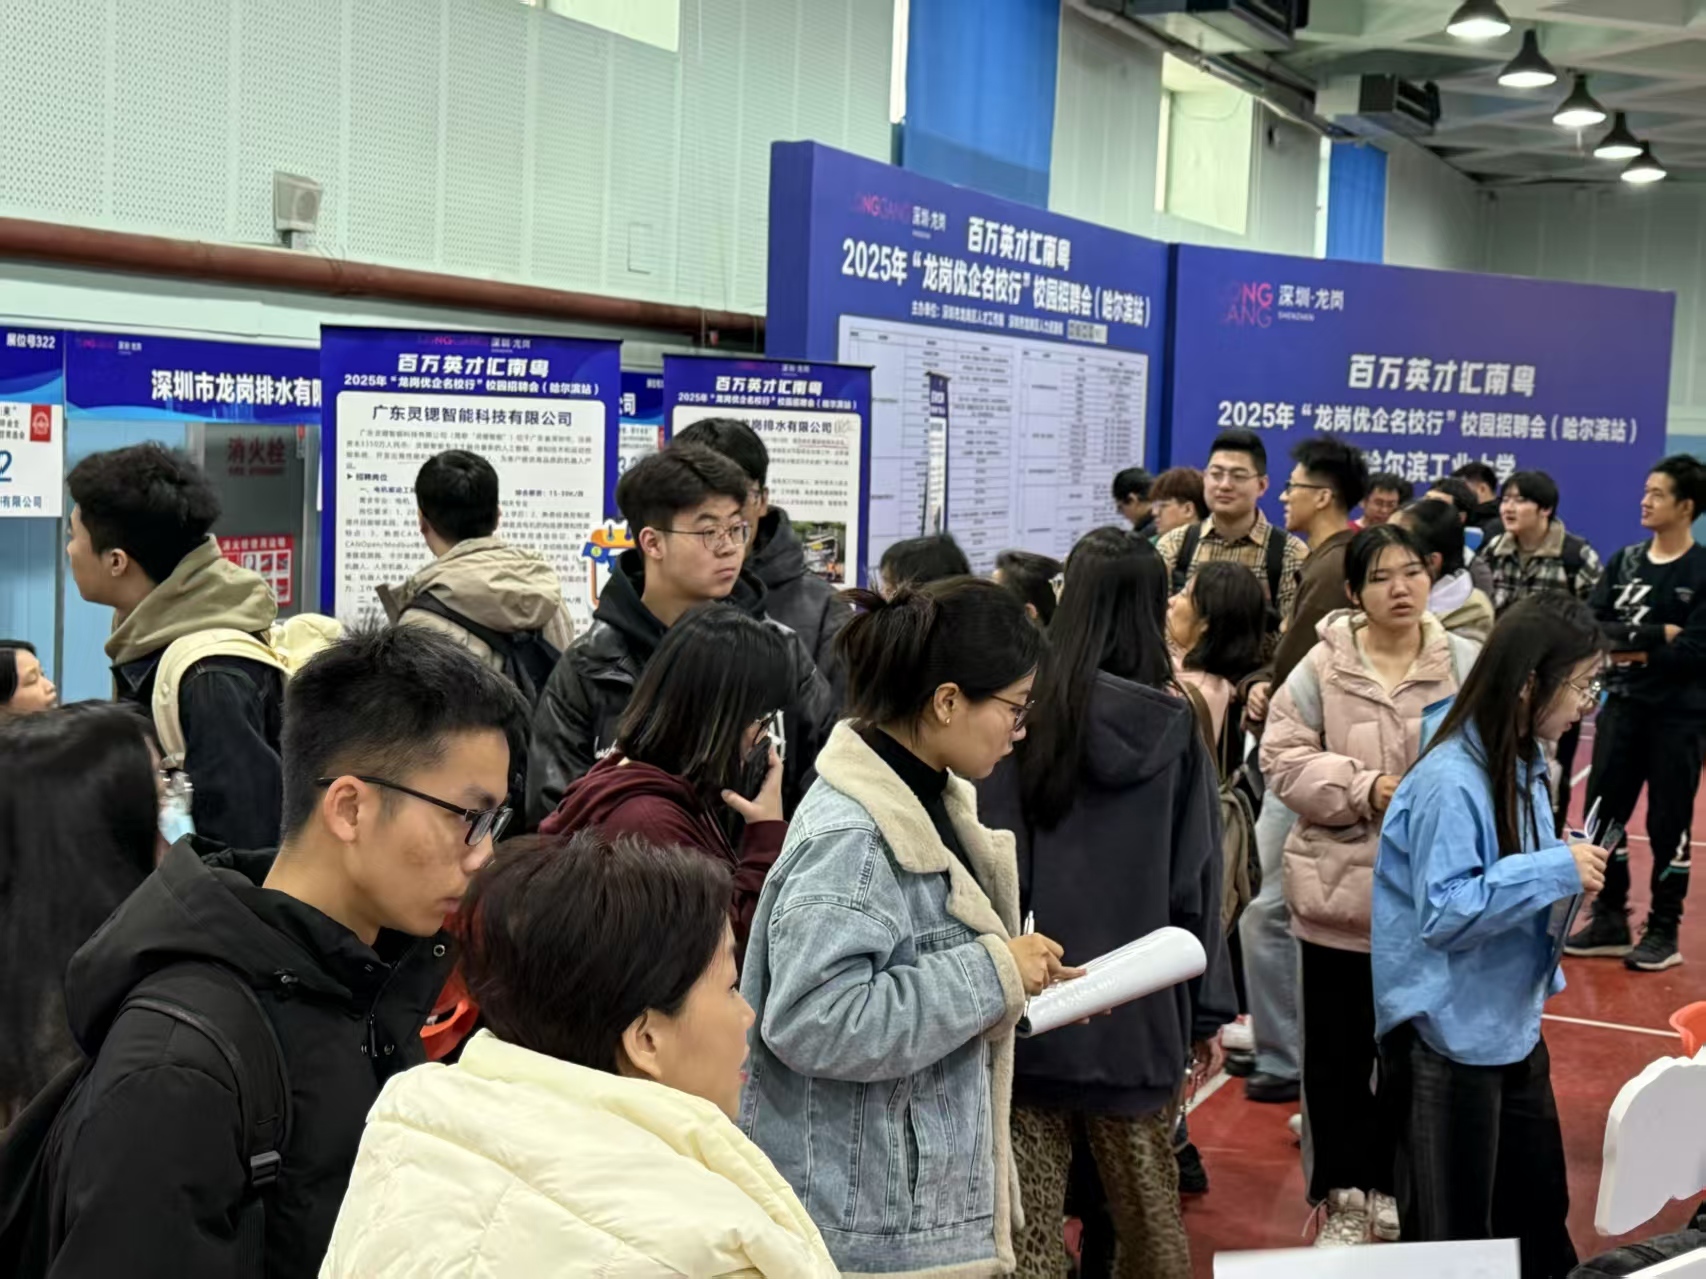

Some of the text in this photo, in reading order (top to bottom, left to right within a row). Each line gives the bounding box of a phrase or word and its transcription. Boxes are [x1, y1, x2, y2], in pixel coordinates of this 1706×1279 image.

[968, 216, 1071, 272] 百万英才汇南粤
[1278, 284, 1345, 311] 深圳·龙岗
[6, 332, 56, 349] 展位号322
[397, 353, 550, 378] 百万英才汇南粤
[1348, 353, 1537, 398] 百万英才汇南粤
[715, 375, 823, 396] 百万英才汇南粤
[372, 404, 573, 427] 广东灵锶智能科技有限公司
[619, 392, 636, 416] 司
[228, 434, 287, 465] 消火栓
[0, 495, 42, 509] 有限公司
